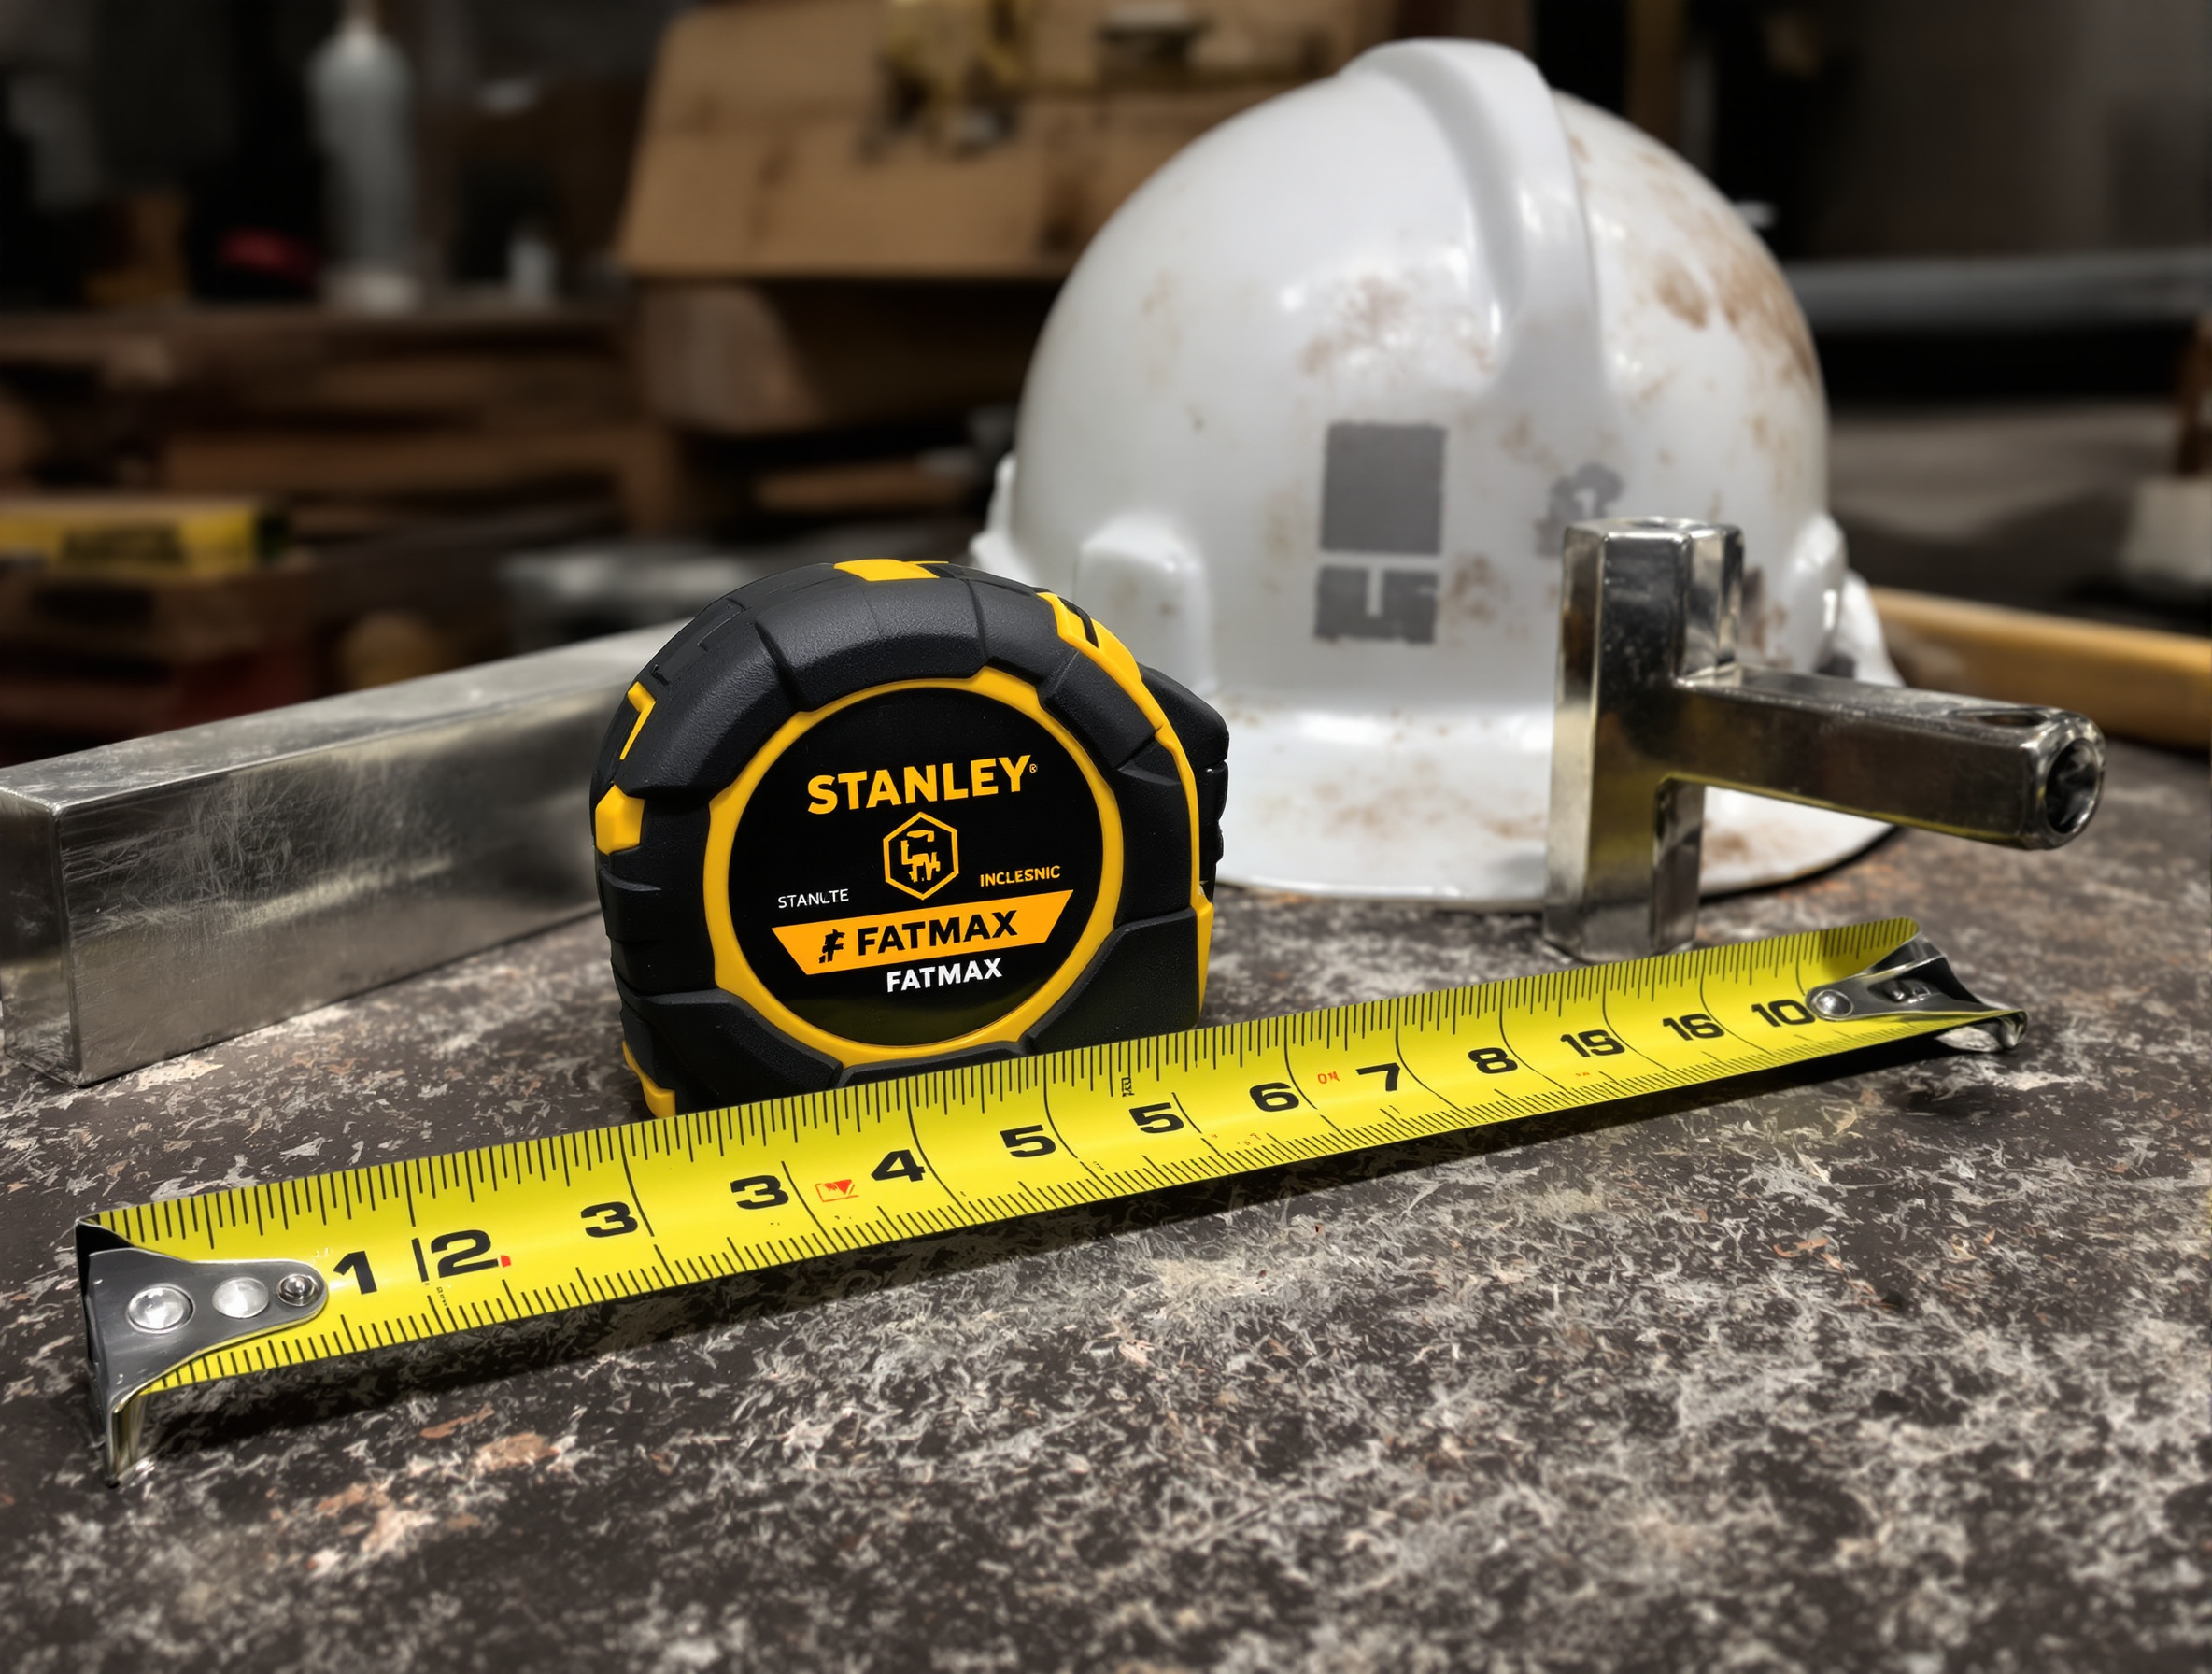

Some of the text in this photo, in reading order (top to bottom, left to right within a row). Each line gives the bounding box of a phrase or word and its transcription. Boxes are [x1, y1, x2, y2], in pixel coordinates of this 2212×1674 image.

[979, 865, 1061, 887] INCLESNIC
[857, 910, 1018, 956] FATMAX
[886, 958, 1003, 993] FATMAX
[333, 1250, 376, 1295] 1
[580, 1201, 638, 1238] 3
[730, 1175, 789, 1210] 3
[871, 1149, 926, 1183] 4
[1000, 1124, 1056, 1158] 5
[1128, 1102, 1184, 1134] 5
[1249, 1082, 1299, 1113] 6
[1355, 1062, 1400, 1092] 7
[1468, 1047, 1518, 1074] 8
[1663, 1014, 1724, 1041] 16
[1751, 1000, 1815, 1027] 10
